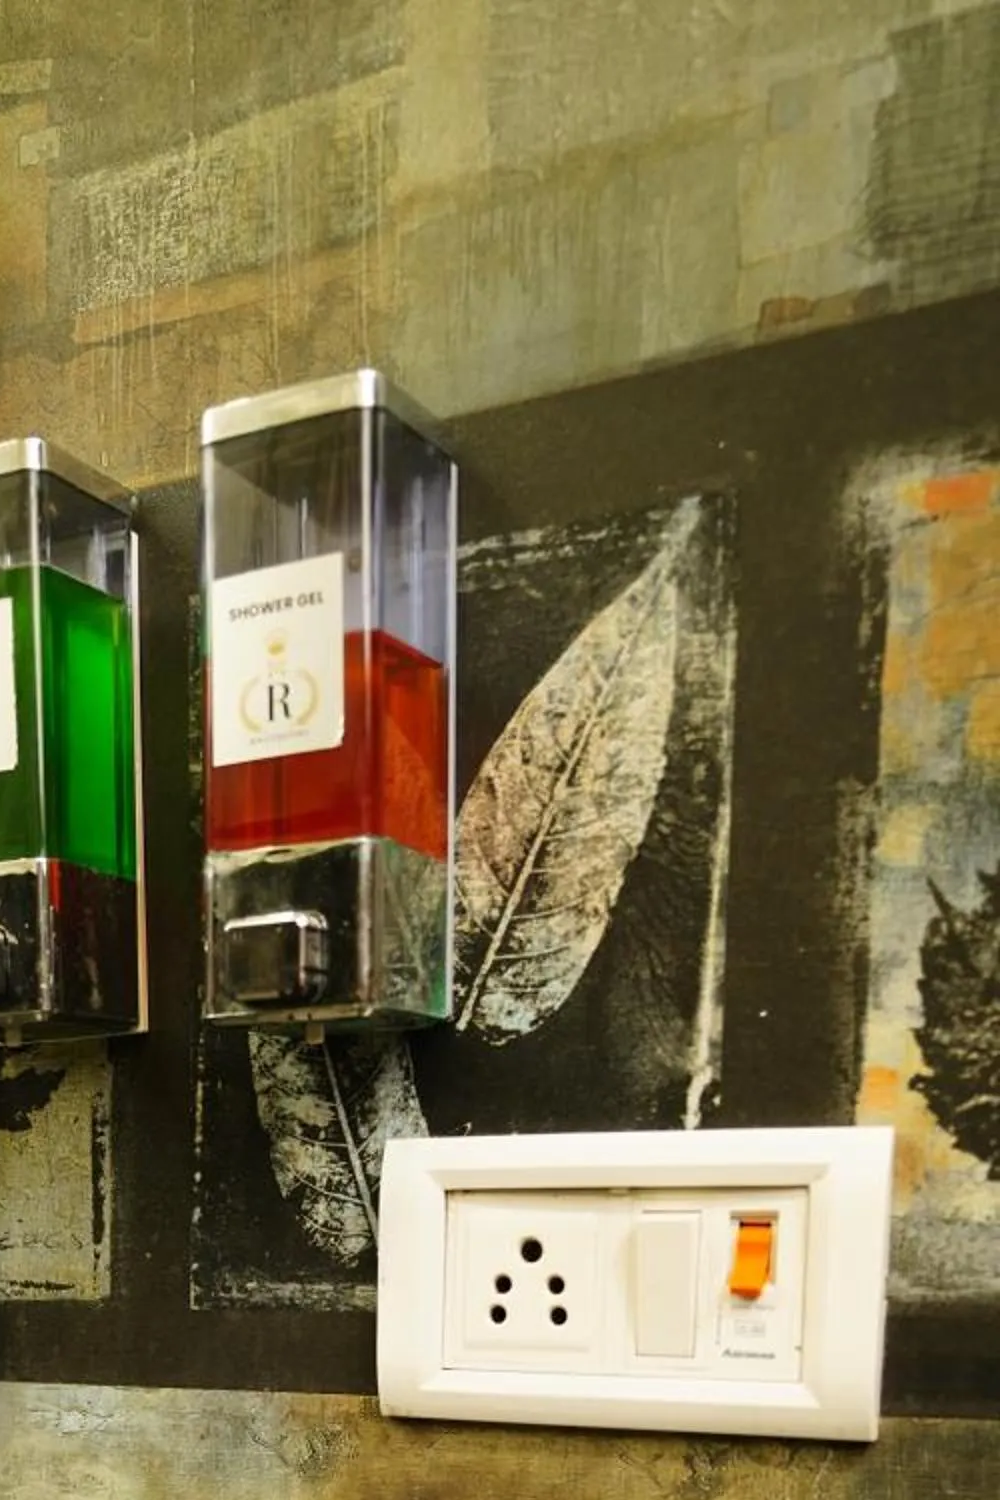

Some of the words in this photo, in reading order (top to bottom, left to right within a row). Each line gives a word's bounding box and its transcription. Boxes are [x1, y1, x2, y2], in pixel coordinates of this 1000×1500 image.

[229, 596, 292, 622] SHOWER
[297, 591, 324, 607] GEL
[267, 682, 291, 721] R
